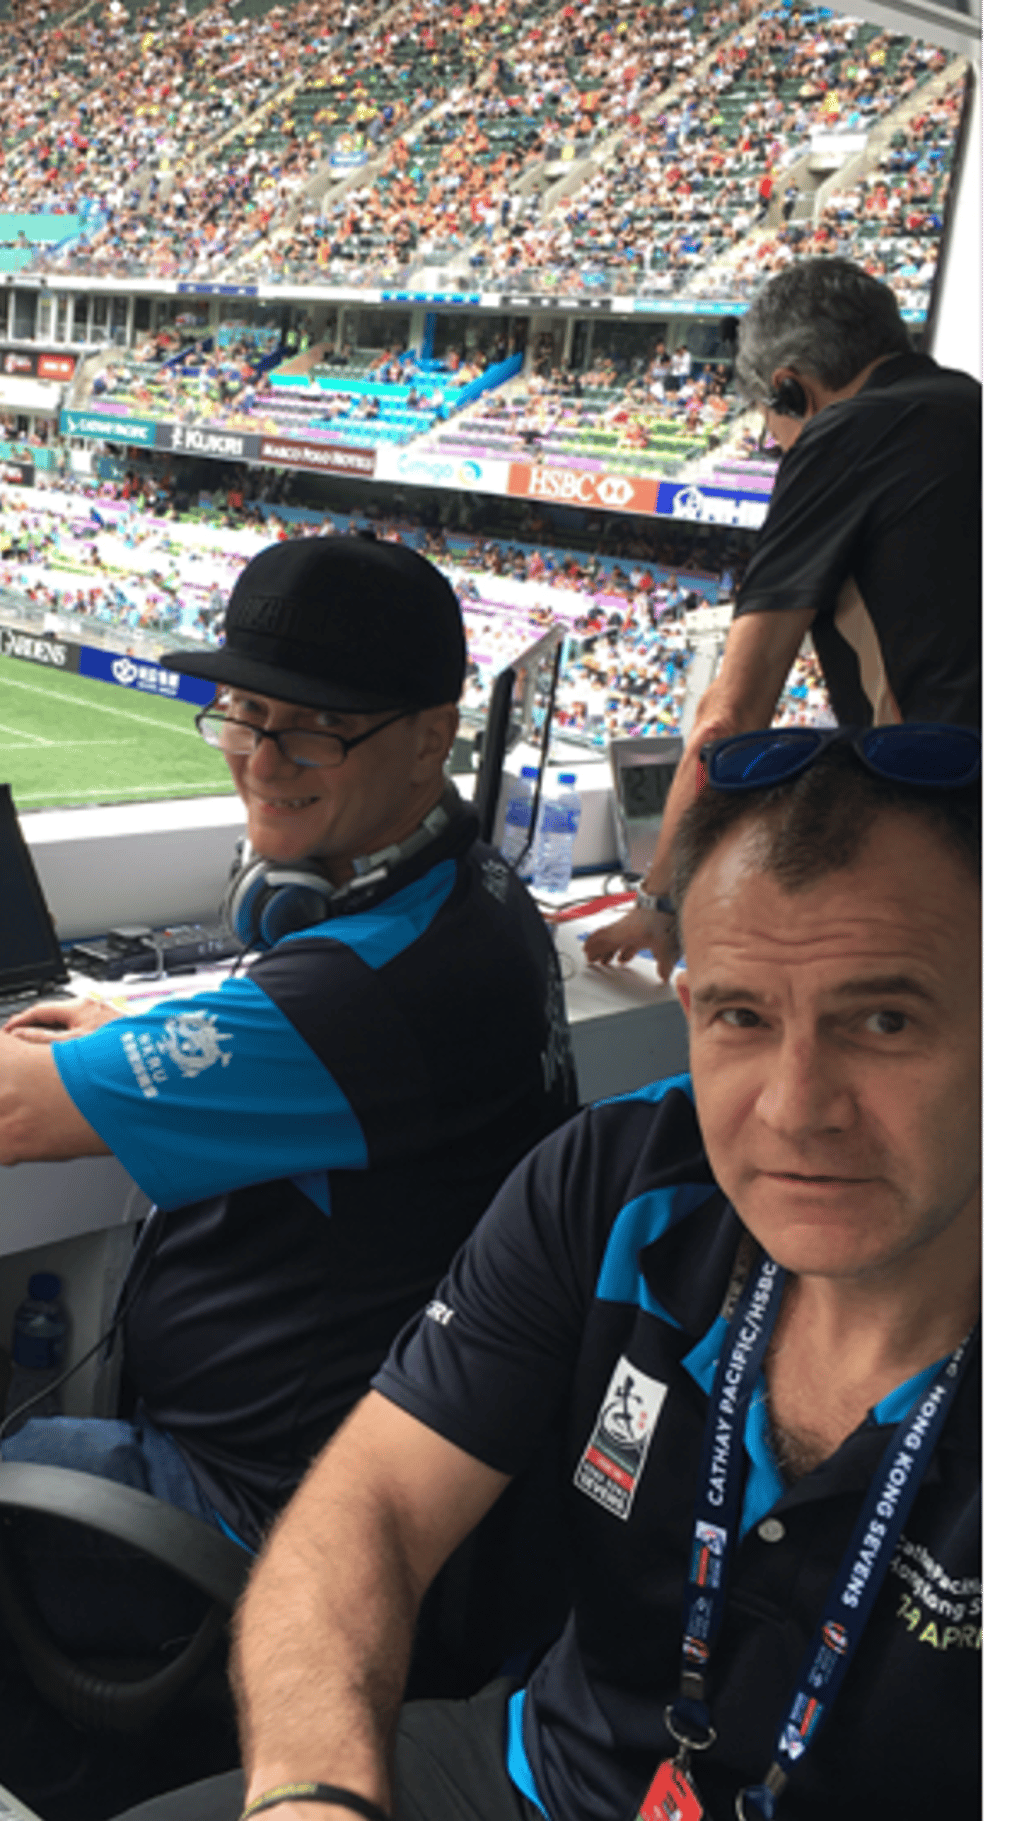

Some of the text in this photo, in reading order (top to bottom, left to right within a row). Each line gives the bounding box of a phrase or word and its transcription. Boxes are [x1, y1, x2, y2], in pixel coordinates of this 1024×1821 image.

[185, 429, 244, 456] KUKRI
[529, 466, 596, 502] HSBC
[718, 1260, 778, 1415] PACIFIC/HSBC
[904, 1384, 947, 1451] HONG
[707, 1418, 732, 1506] CATHAY
[876, 1451, 915, 1519] KONG
[841, 1518, 888, 1609] SEVENS
